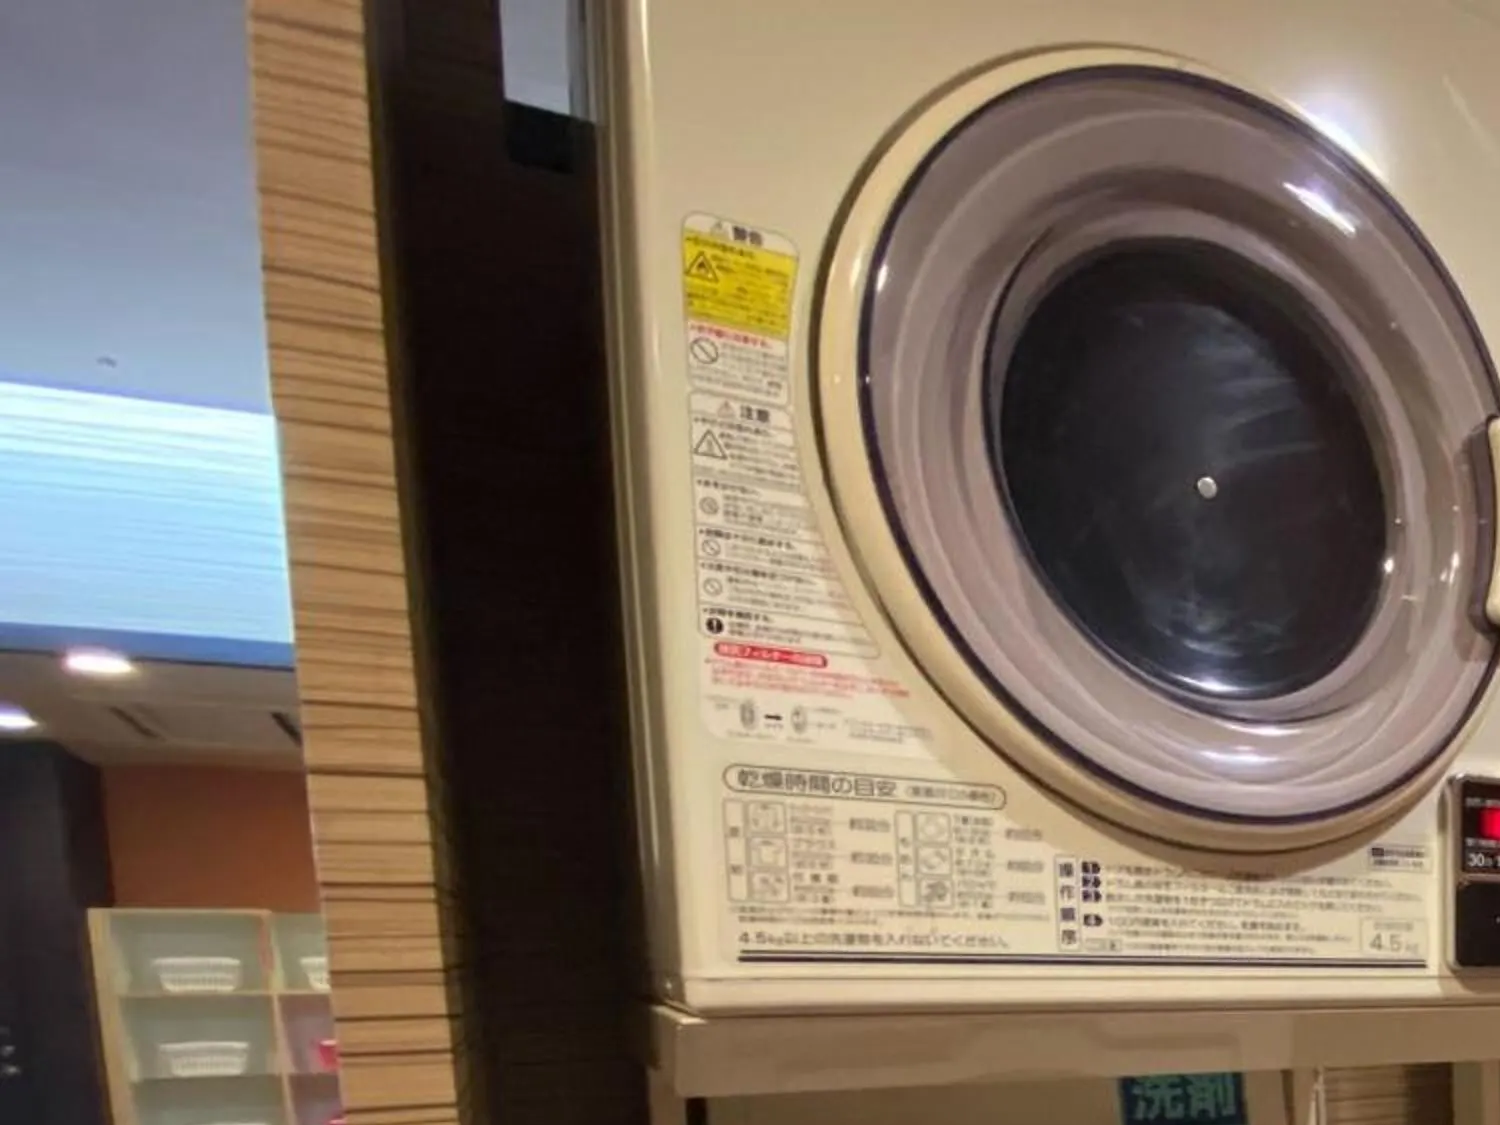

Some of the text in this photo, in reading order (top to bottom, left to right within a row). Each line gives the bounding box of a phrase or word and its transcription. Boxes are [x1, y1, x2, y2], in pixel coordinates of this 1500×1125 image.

[737, 768, 897, 797] 乾燥時間の目安
